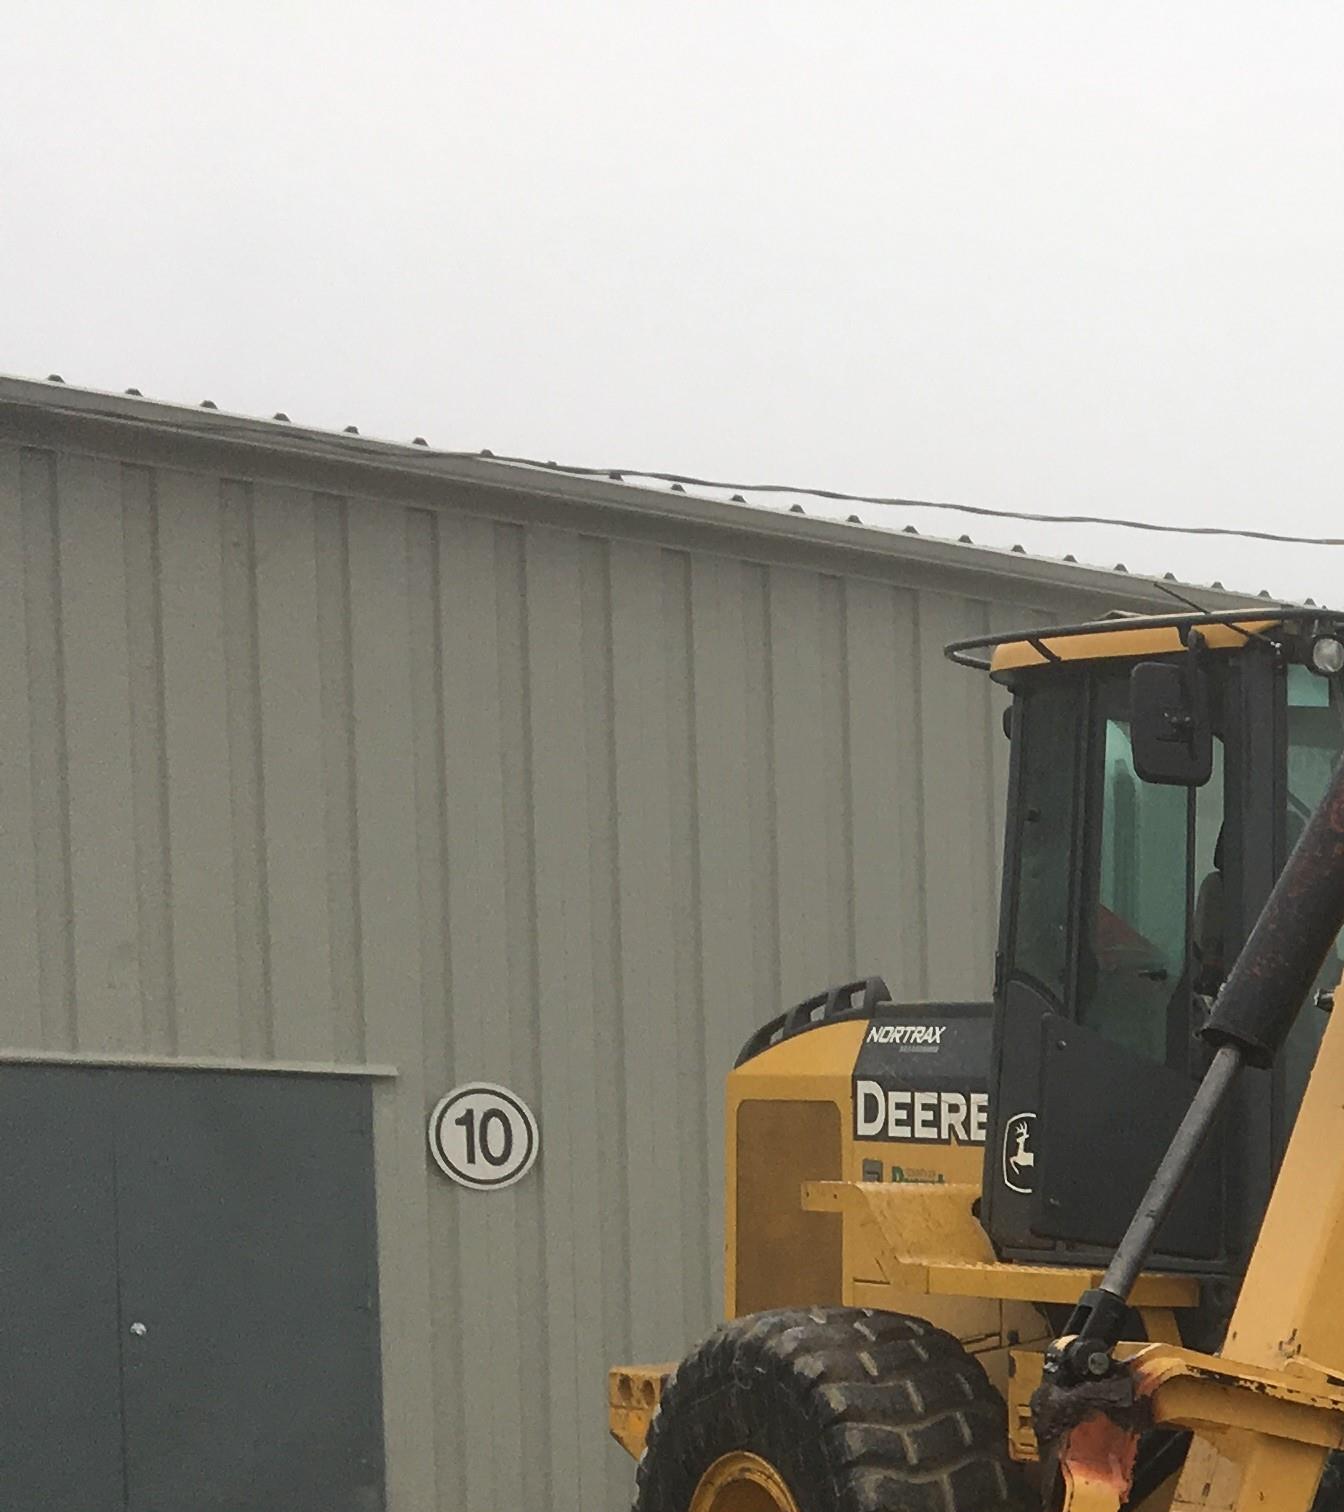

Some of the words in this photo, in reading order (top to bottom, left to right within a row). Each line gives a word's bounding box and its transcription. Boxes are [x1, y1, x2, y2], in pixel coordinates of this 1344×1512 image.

[866, 1026, 946, 1044] NORTRAX
[455, 1108, 512, 1166] 10
[856, 1080, 989, 1141] DEERE
